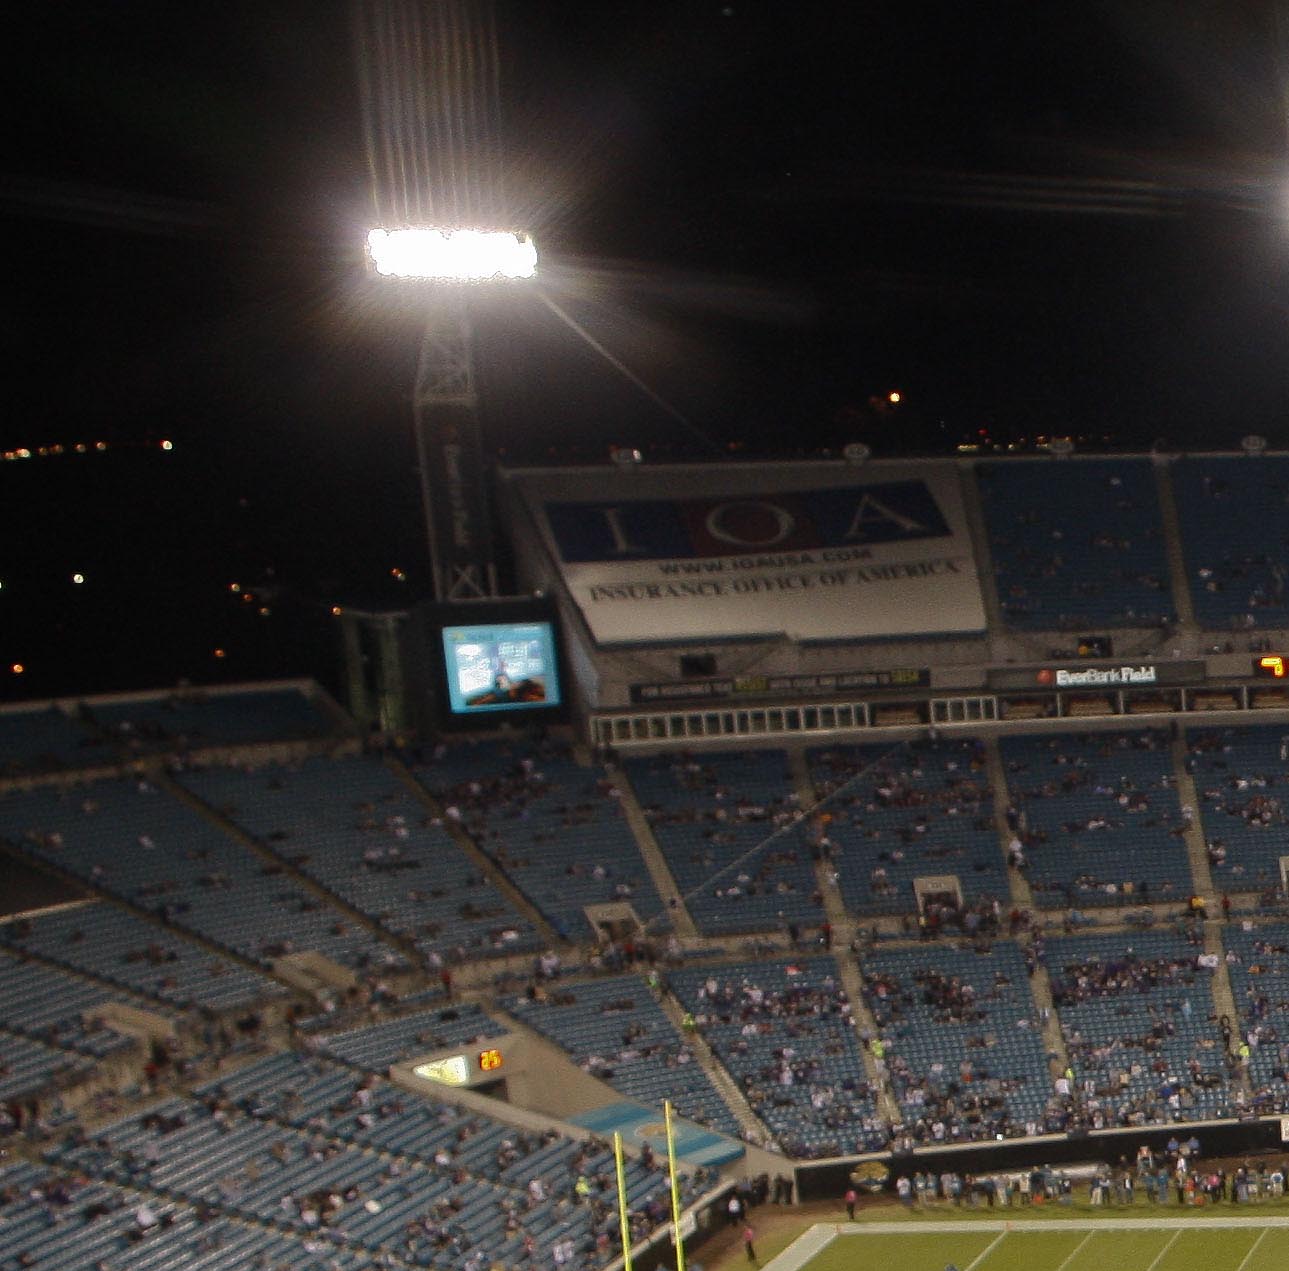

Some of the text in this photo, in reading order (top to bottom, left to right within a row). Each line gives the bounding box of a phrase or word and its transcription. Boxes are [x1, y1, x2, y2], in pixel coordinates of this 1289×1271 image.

[590, 558, 962, 602] INSURANCE OFFICE OF AMERICA
[1056, 666, 1156, 686] EverBank Field
